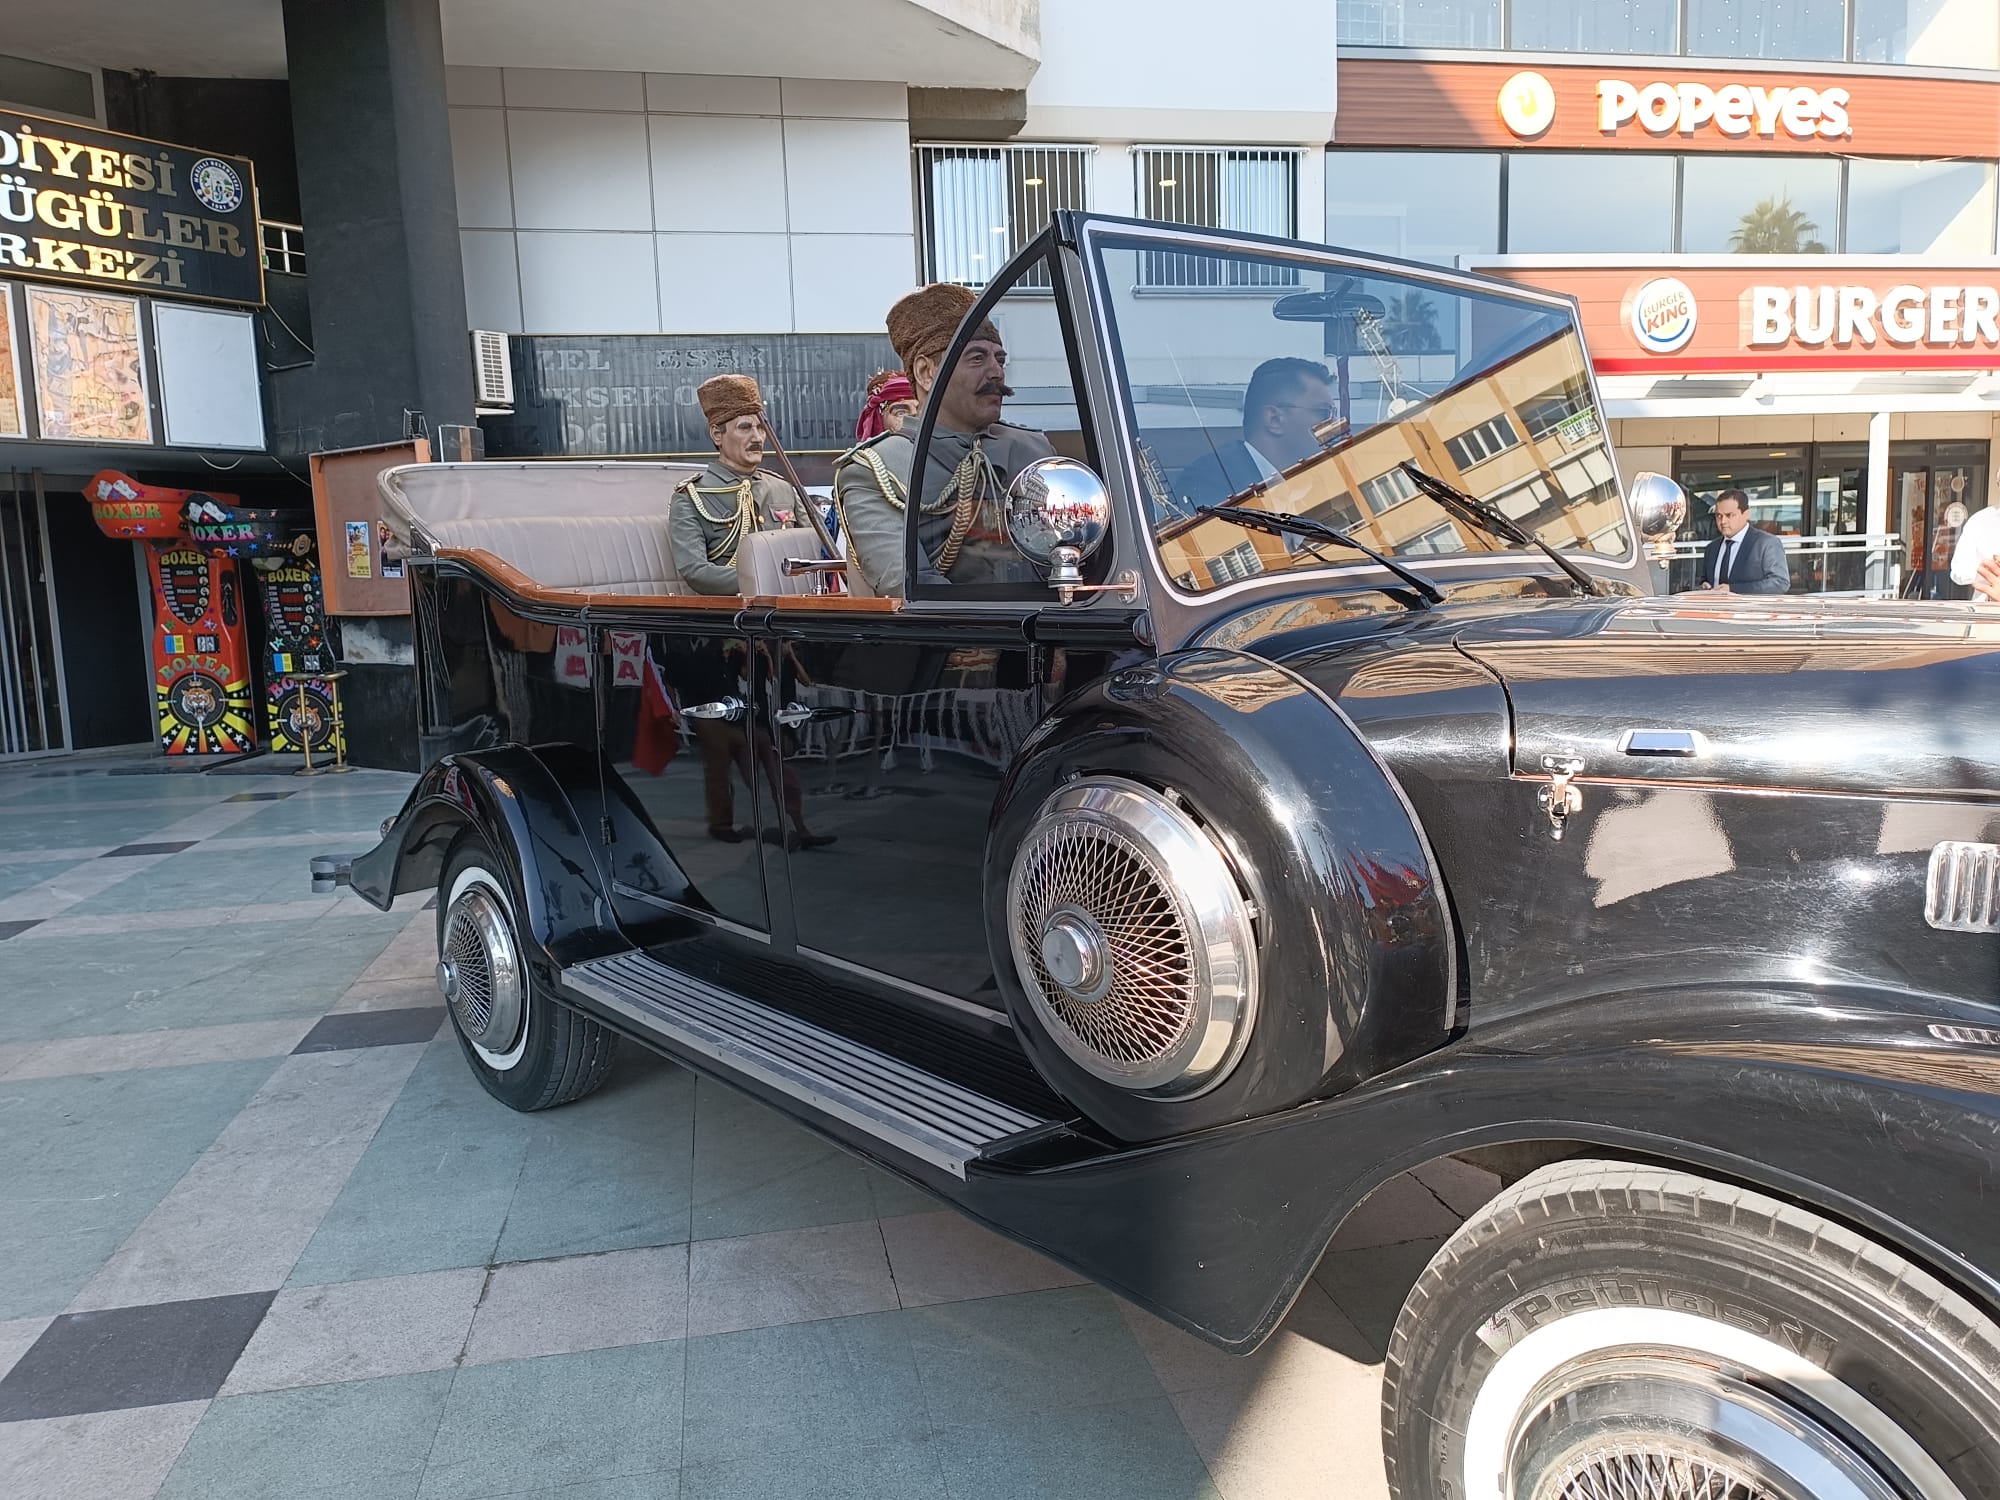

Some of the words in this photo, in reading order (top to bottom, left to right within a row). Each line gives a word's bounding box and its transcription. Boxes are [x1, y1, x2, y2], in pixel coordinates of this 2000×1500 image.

[1644, 291, 1684, 318] BURGER
[1647, 301, 1687, 333] KING
[1752, 284, 2000, 345] BURGER
[161, 551, 206, 565] BOXER
[268, 568, 310, 583] BOXER
[159, 654, 231, 681] BOXER
